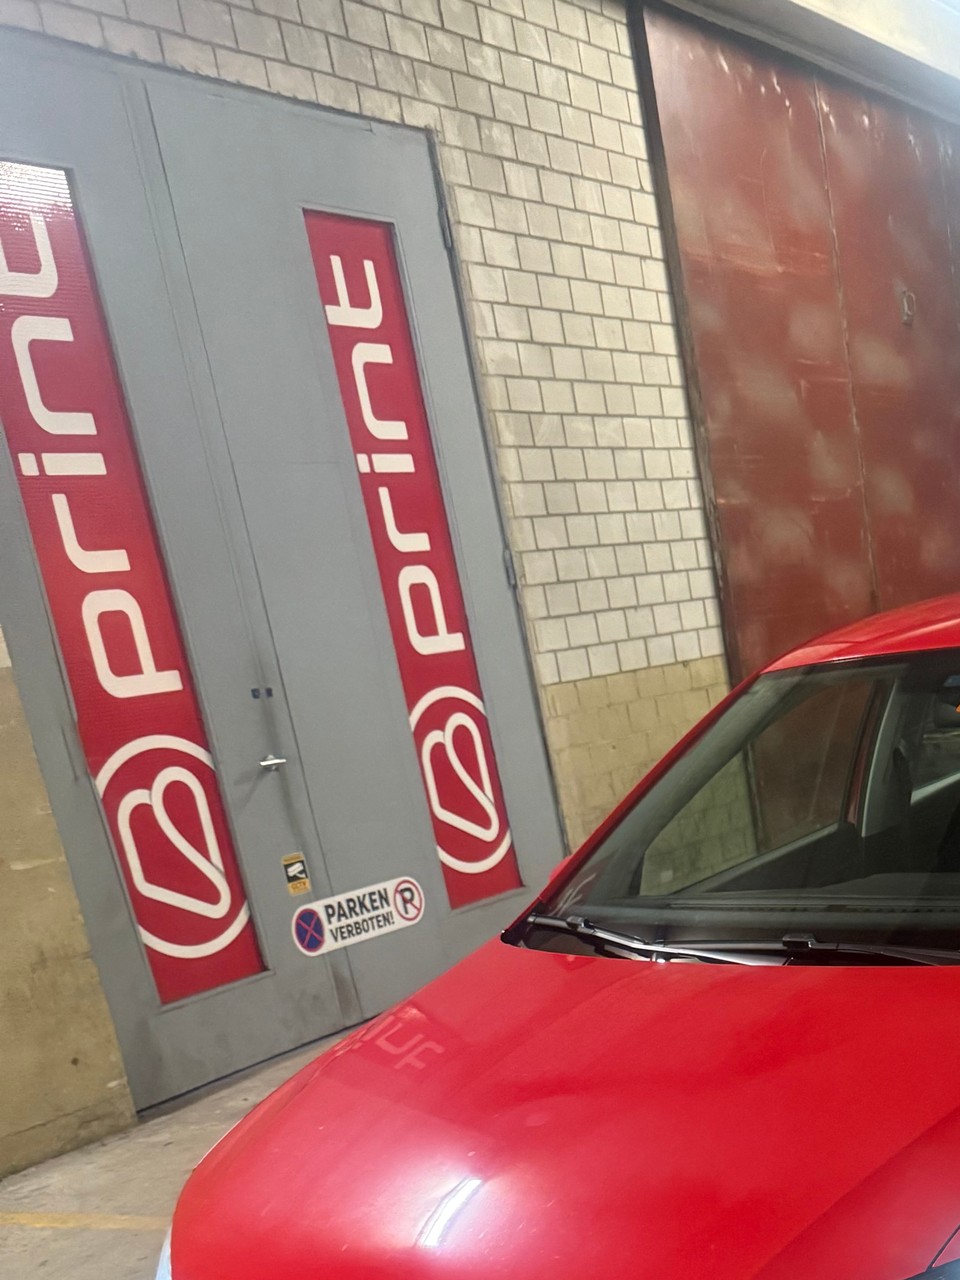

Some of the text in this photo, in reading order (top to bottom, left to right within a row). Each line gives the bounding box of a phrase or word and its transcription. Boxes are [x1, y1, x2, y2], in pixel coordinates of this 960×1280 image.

[324, 254, 466, 656] print
[324, 887, 391, 925] PARKEN
[330, 910, 396, 943] VERBOTEN!
